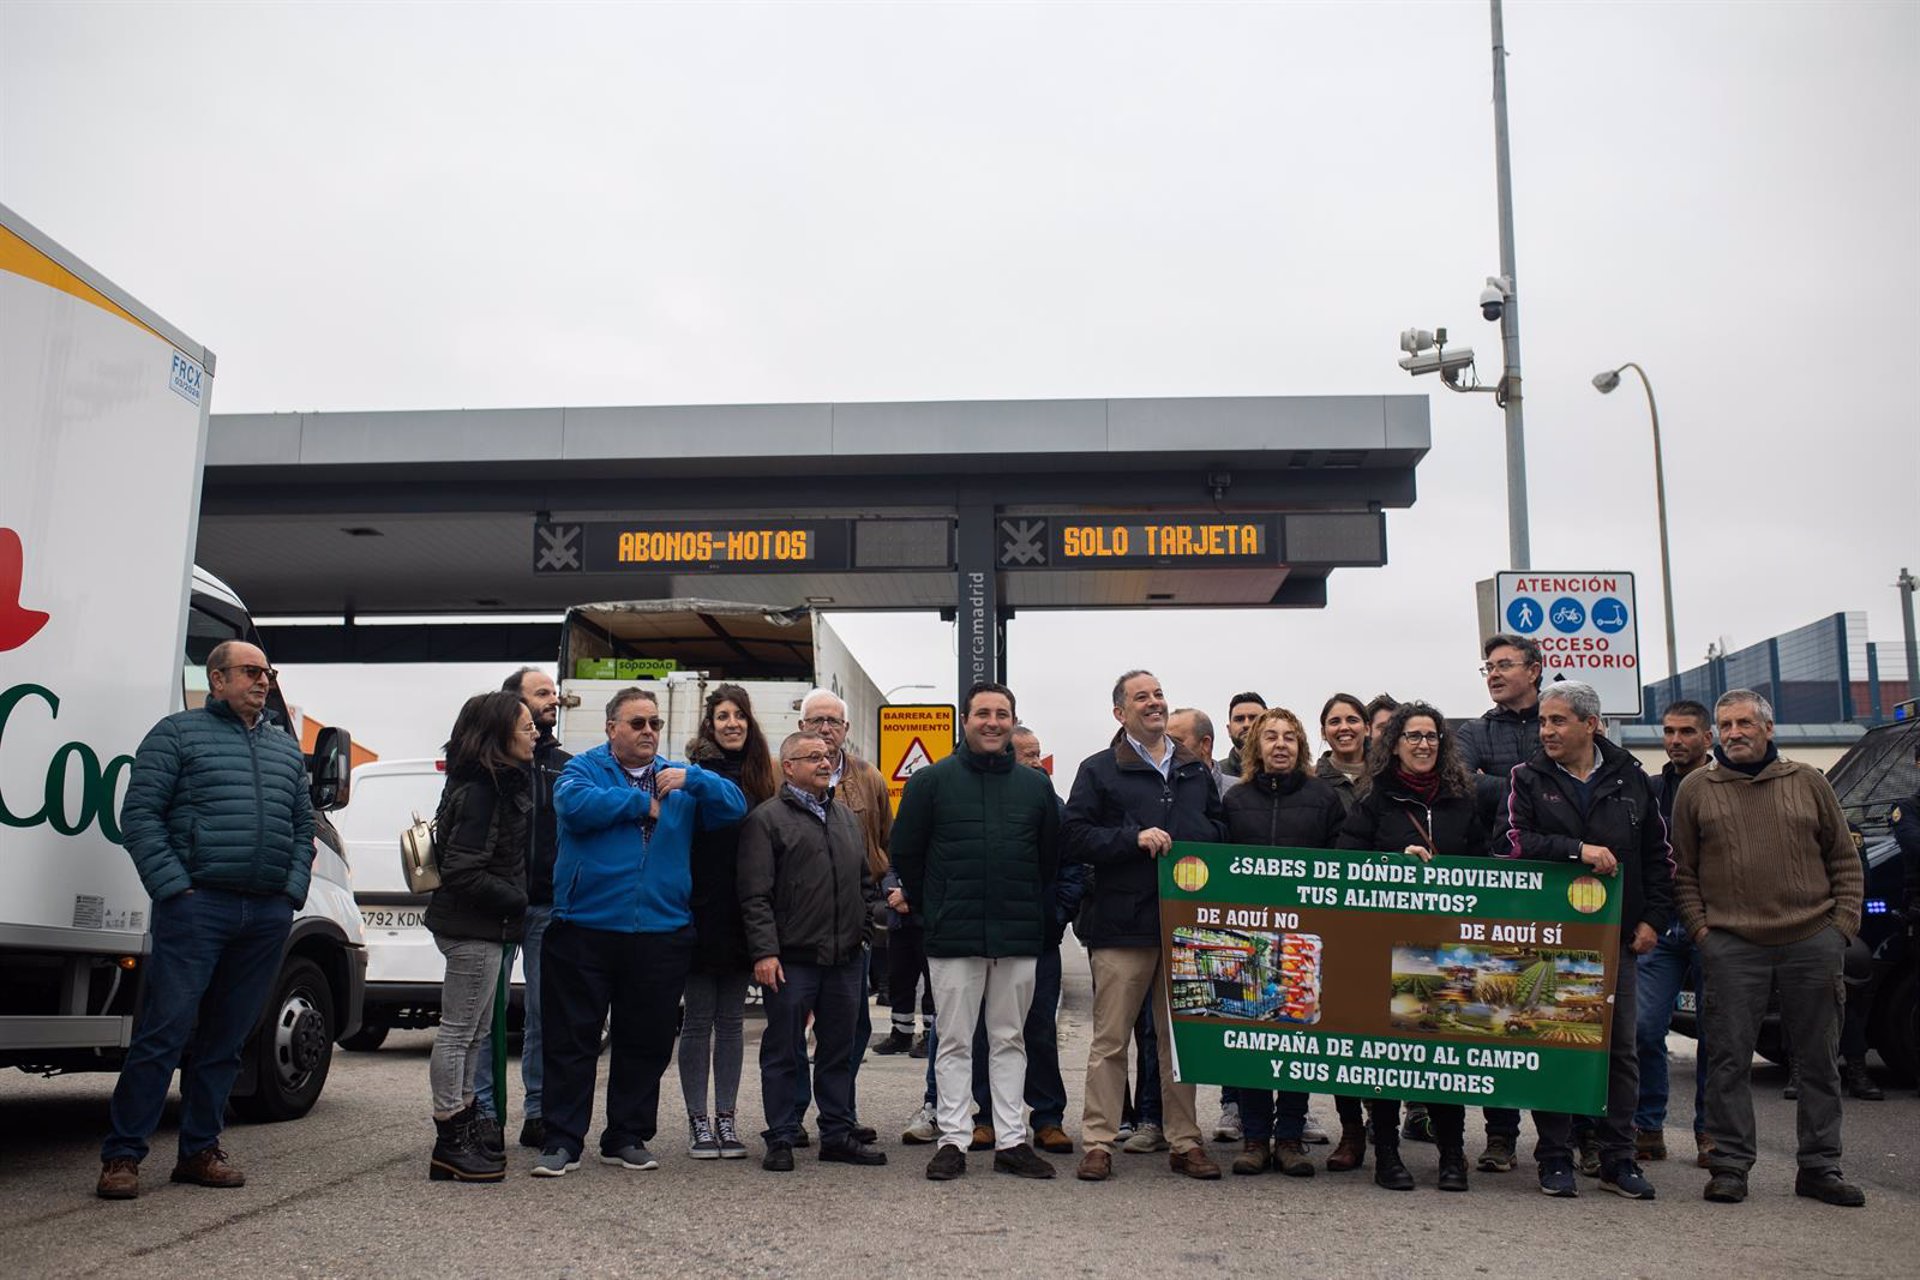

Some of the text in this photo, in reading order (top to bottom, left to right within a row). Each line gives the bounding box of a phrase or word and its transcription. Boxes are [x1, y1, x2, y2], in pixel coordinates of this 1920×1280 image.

[173, 355, 201, 388] FRCX
[619, 531, 806, 562] ABONOS-MOTOS
[1064, 525, 1257, 556] SOLO TARJETA
[1516, 576, 1616, 592] ATENCIÓN
[619, 661, 673, 671] avocados
[1542, 654, 1636, 668] IGATORIO
[883, 712, 933, 720] BARRERA
[883, 723, 950, 731] MOVIMIENTO
[1229, 856, 1543, 890] ¿SABES DE DÓNDE PROVIENEN
[1297, 886, 1478, 913] TUS ALIMENTOS?
[397, 912, 425, 926] KDN
[1197, 907, 1299, 929] DE AQUÍ NO
[1460, 922, 1563, 945] DE AQUÍ SÍ
[1223, 1030, 1540, 1071] CAMPAÑA DE APOYO AL CAMPO
[1270, 1059, 1495, 1094] Y SUS AGRICULTORES
